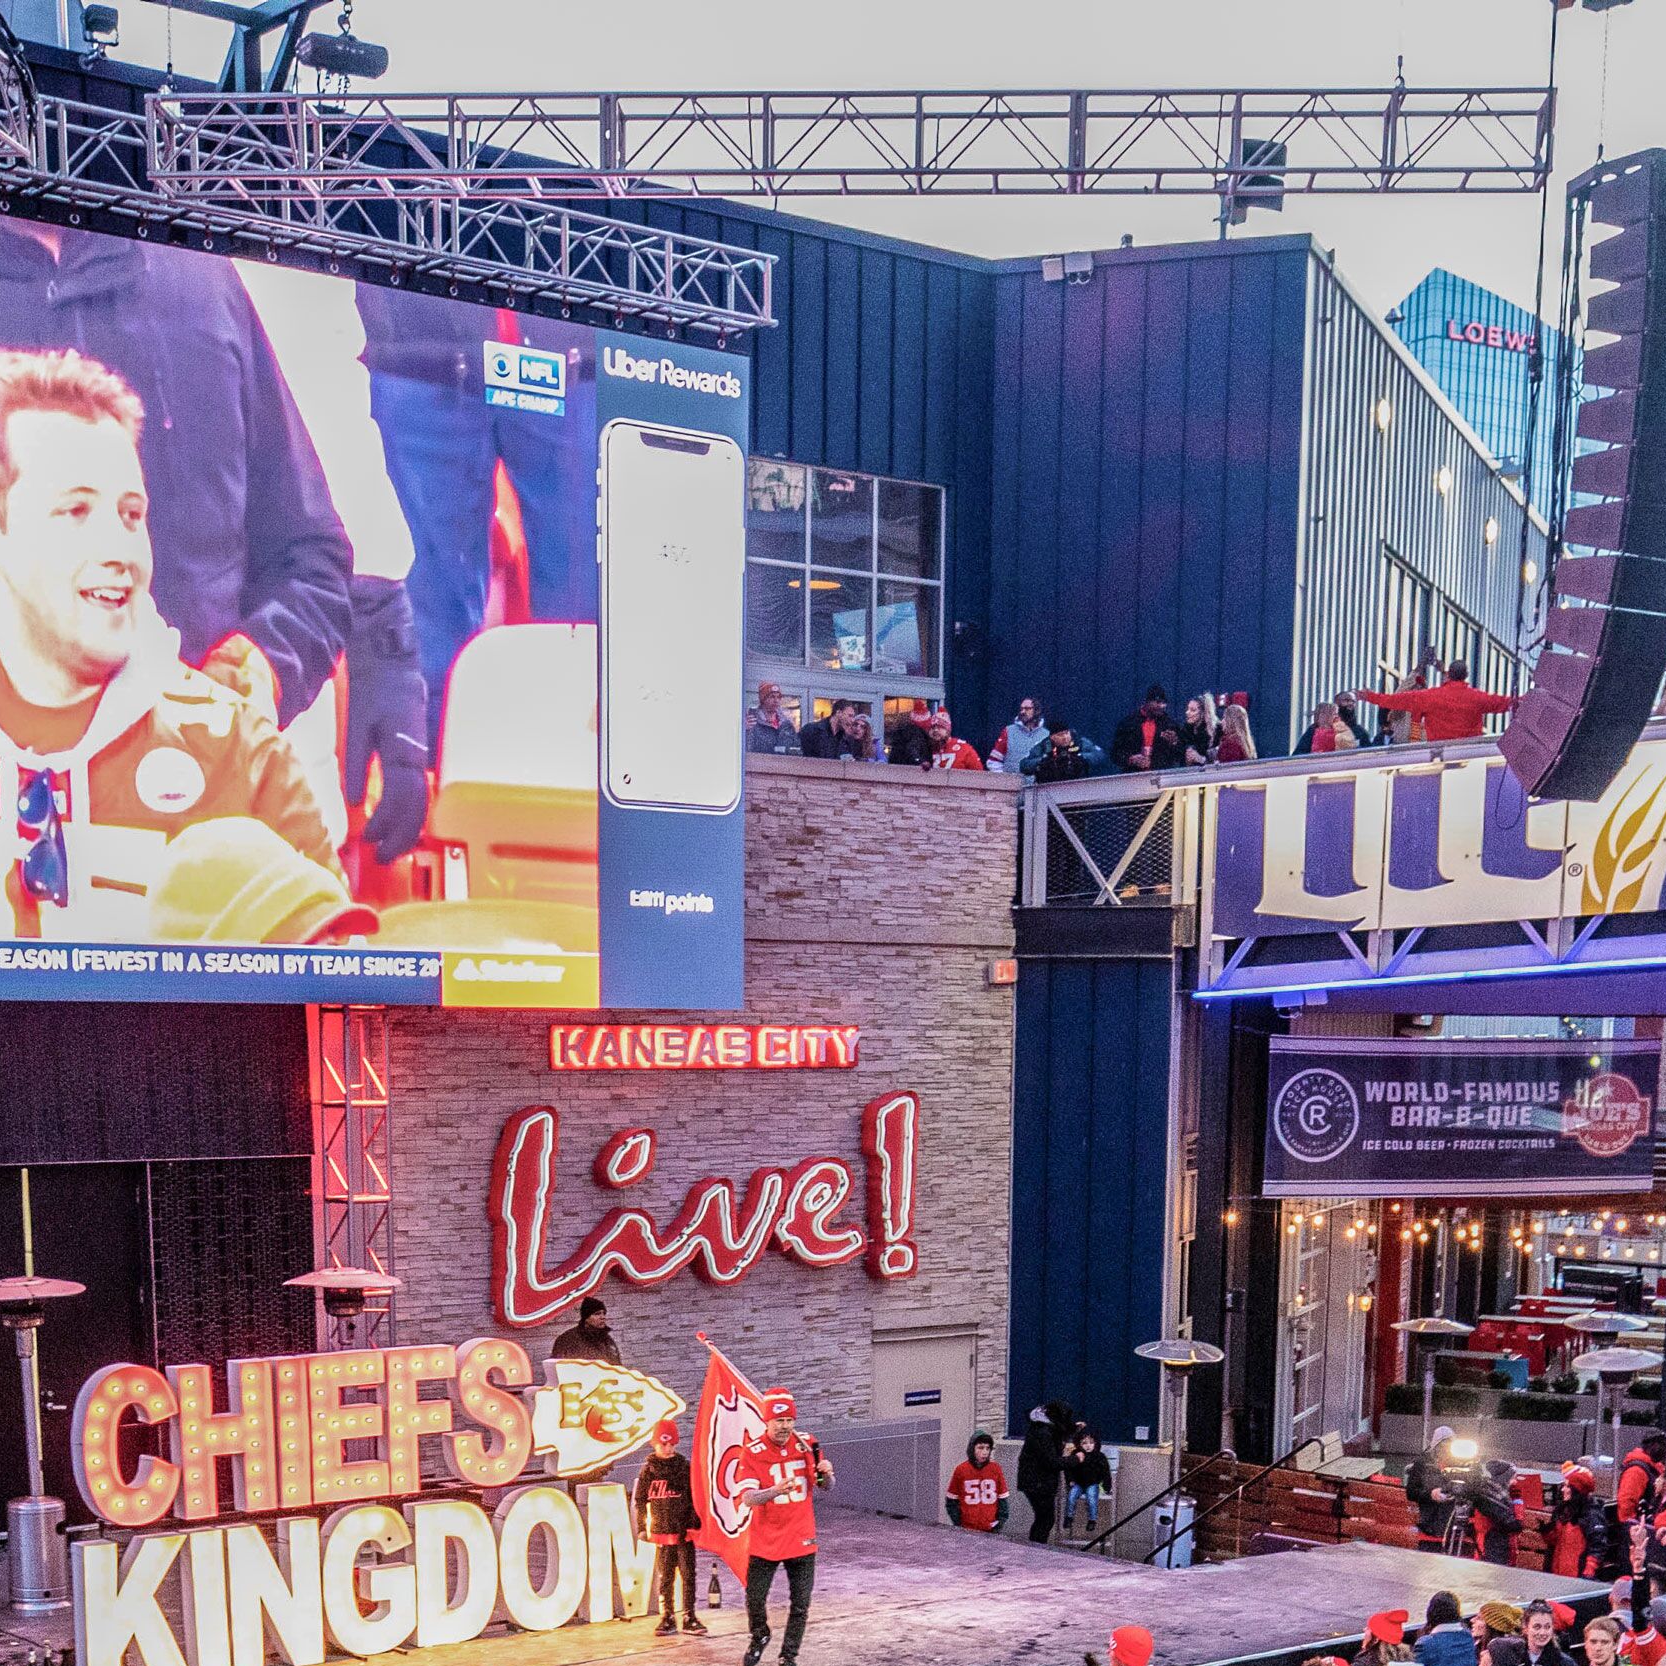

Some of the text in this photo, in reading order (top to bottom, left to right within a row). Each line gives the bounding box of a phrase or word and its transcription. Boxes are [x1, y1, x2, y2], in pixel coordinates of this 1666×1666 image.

[521, 358, 558, 386] NFL
[603, 347, 741, 398] Uber Rewards
[665, 893, 713, 914] points
[72, 950, 159, 972] (FEWEST
[162, 951, 183, 972] IN
[187, 952, 202, 973] A
[204, 953, 279, 974] SEASON
[284, 955, 308, 975] BY
[310, 955, 361, 976] TEAM
[363, 957, 415, 977] SINCE
[552, 1026, 860, 1068] KANSAS CITY
[1364, 1080, 1559, 1103] WORLD-FAMOUS
[1391, 1105, 1532, 1128] BAR-B-QUE
[1362, 1138, 1556, 1151] ICE COLD BEER FROZEN COCKTAILS
[488, 1091, 920, 1328] Live!
[72, 1337, 534, 1526] CHIEFS
[768, 1460, 807, 1504] 15
[964, 1479, 997, 1504] 58
